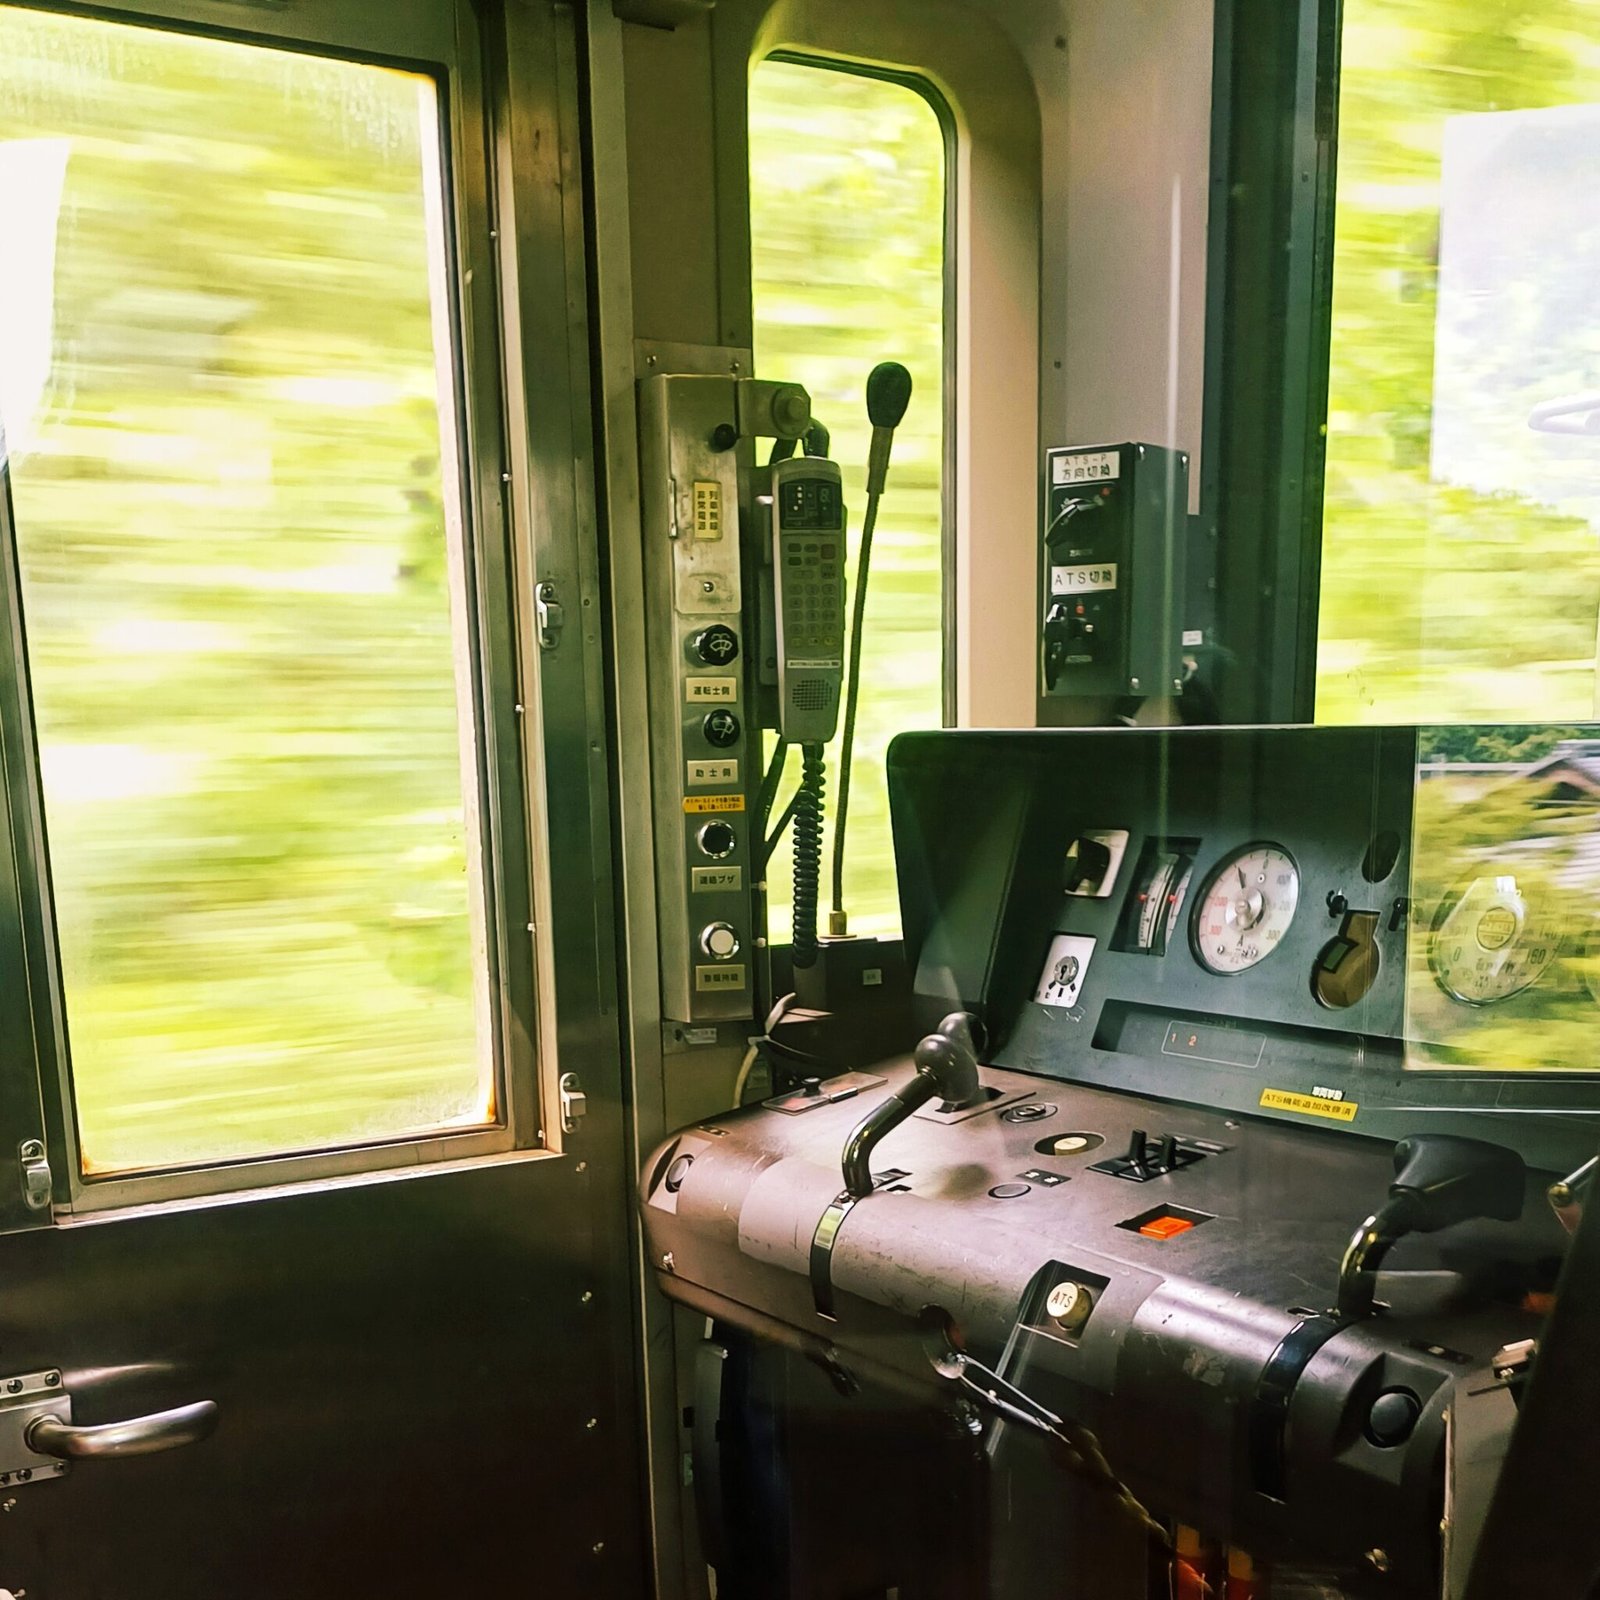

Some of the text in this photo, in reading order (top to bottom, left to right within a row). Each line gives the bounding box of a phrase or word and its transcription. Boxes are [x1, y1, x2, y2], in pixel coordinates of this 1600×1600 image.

[1064, 453, 1107, 466] ATS-P
[693, 685, 730, 696] 運転士側
[1188, 1034, 1198, 1047] 2
[1051, 1291, 1073, 1308] ATS
